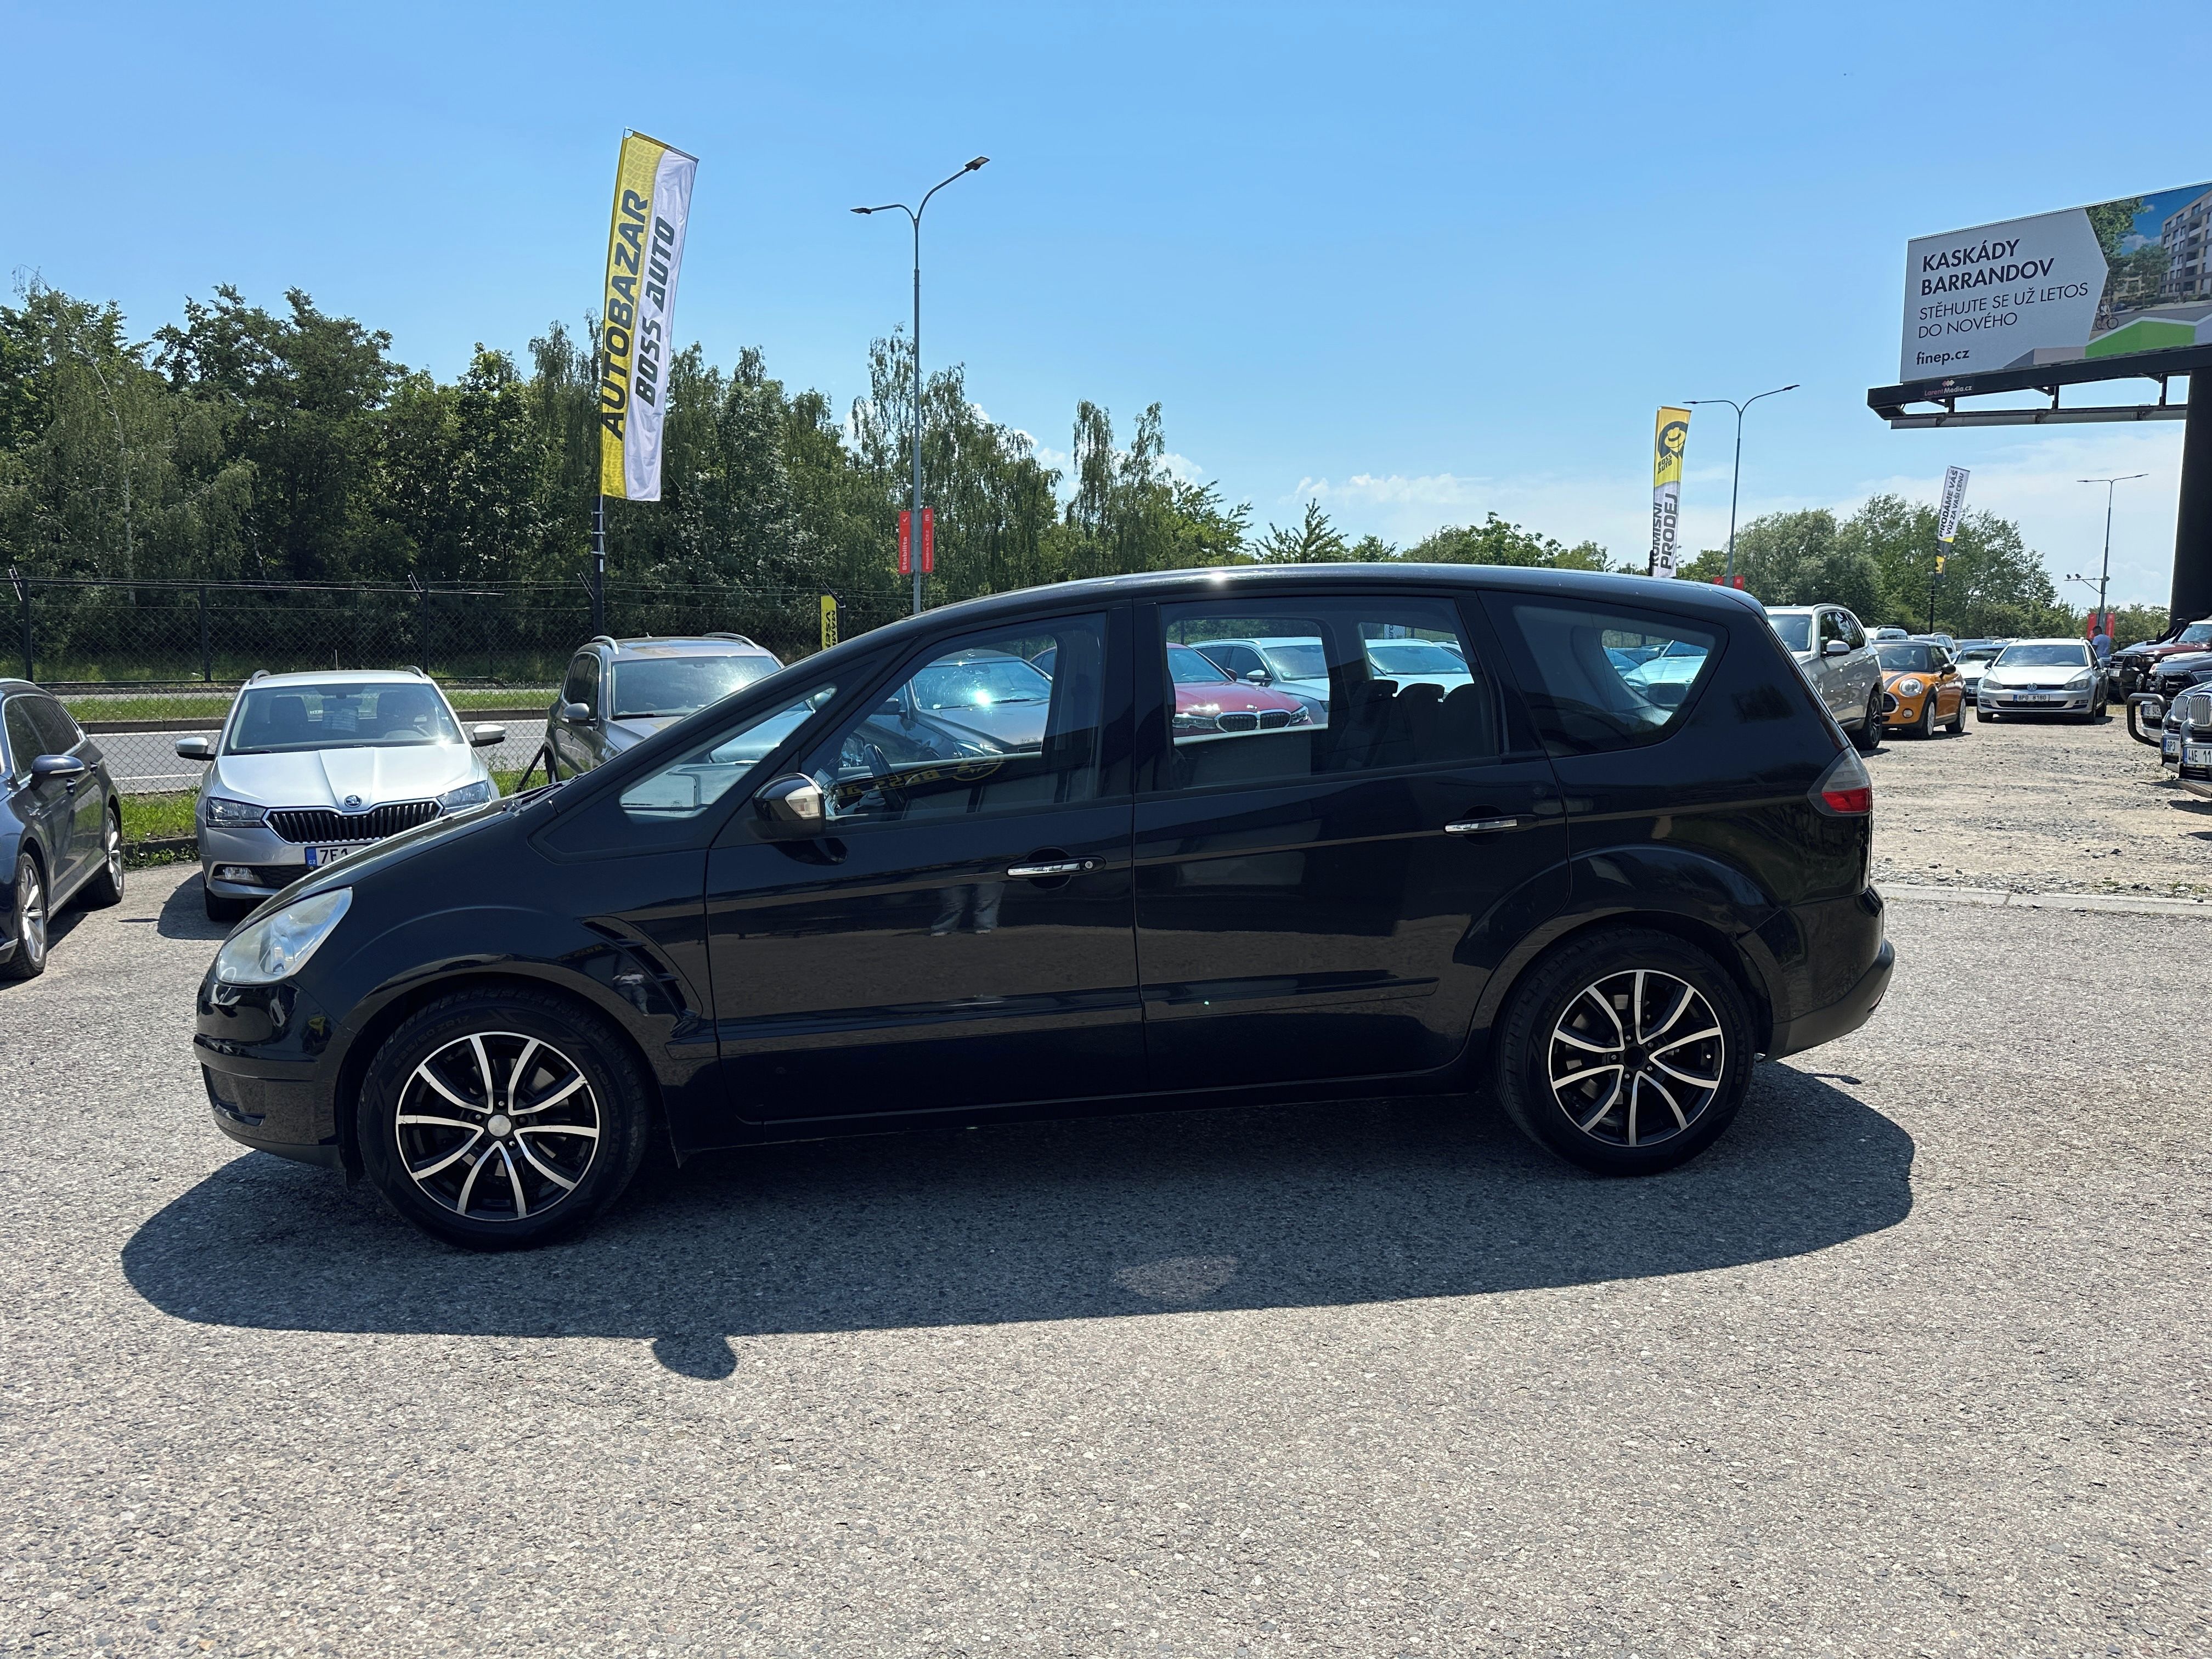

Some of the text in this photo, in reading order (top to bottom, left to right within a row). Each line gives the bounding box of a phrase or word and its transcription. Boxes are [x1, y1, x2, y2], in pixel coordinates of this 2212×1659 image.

[1922, 239, 2021, 273] KASKÁDY
[1921, 257, 2055, 297] BARRANDOV
[601, 189, 649, 441] AUTOBAZAR
[636, 216, 675, 408] BOSS AUTO
[1919, 282, 2089, 321] STĚHUJTE SE UŽ LETOS
[1918, 312, 2018, 338] DO NOVÉHO
[1916, 348, 1970, 366] finep.cz
[1939, 469, 1958, 537] PRODÁME VÁŠ
[1950, 510, 1957, 520] ZA
[1660, 493, 1678, 569] PRODEJ
